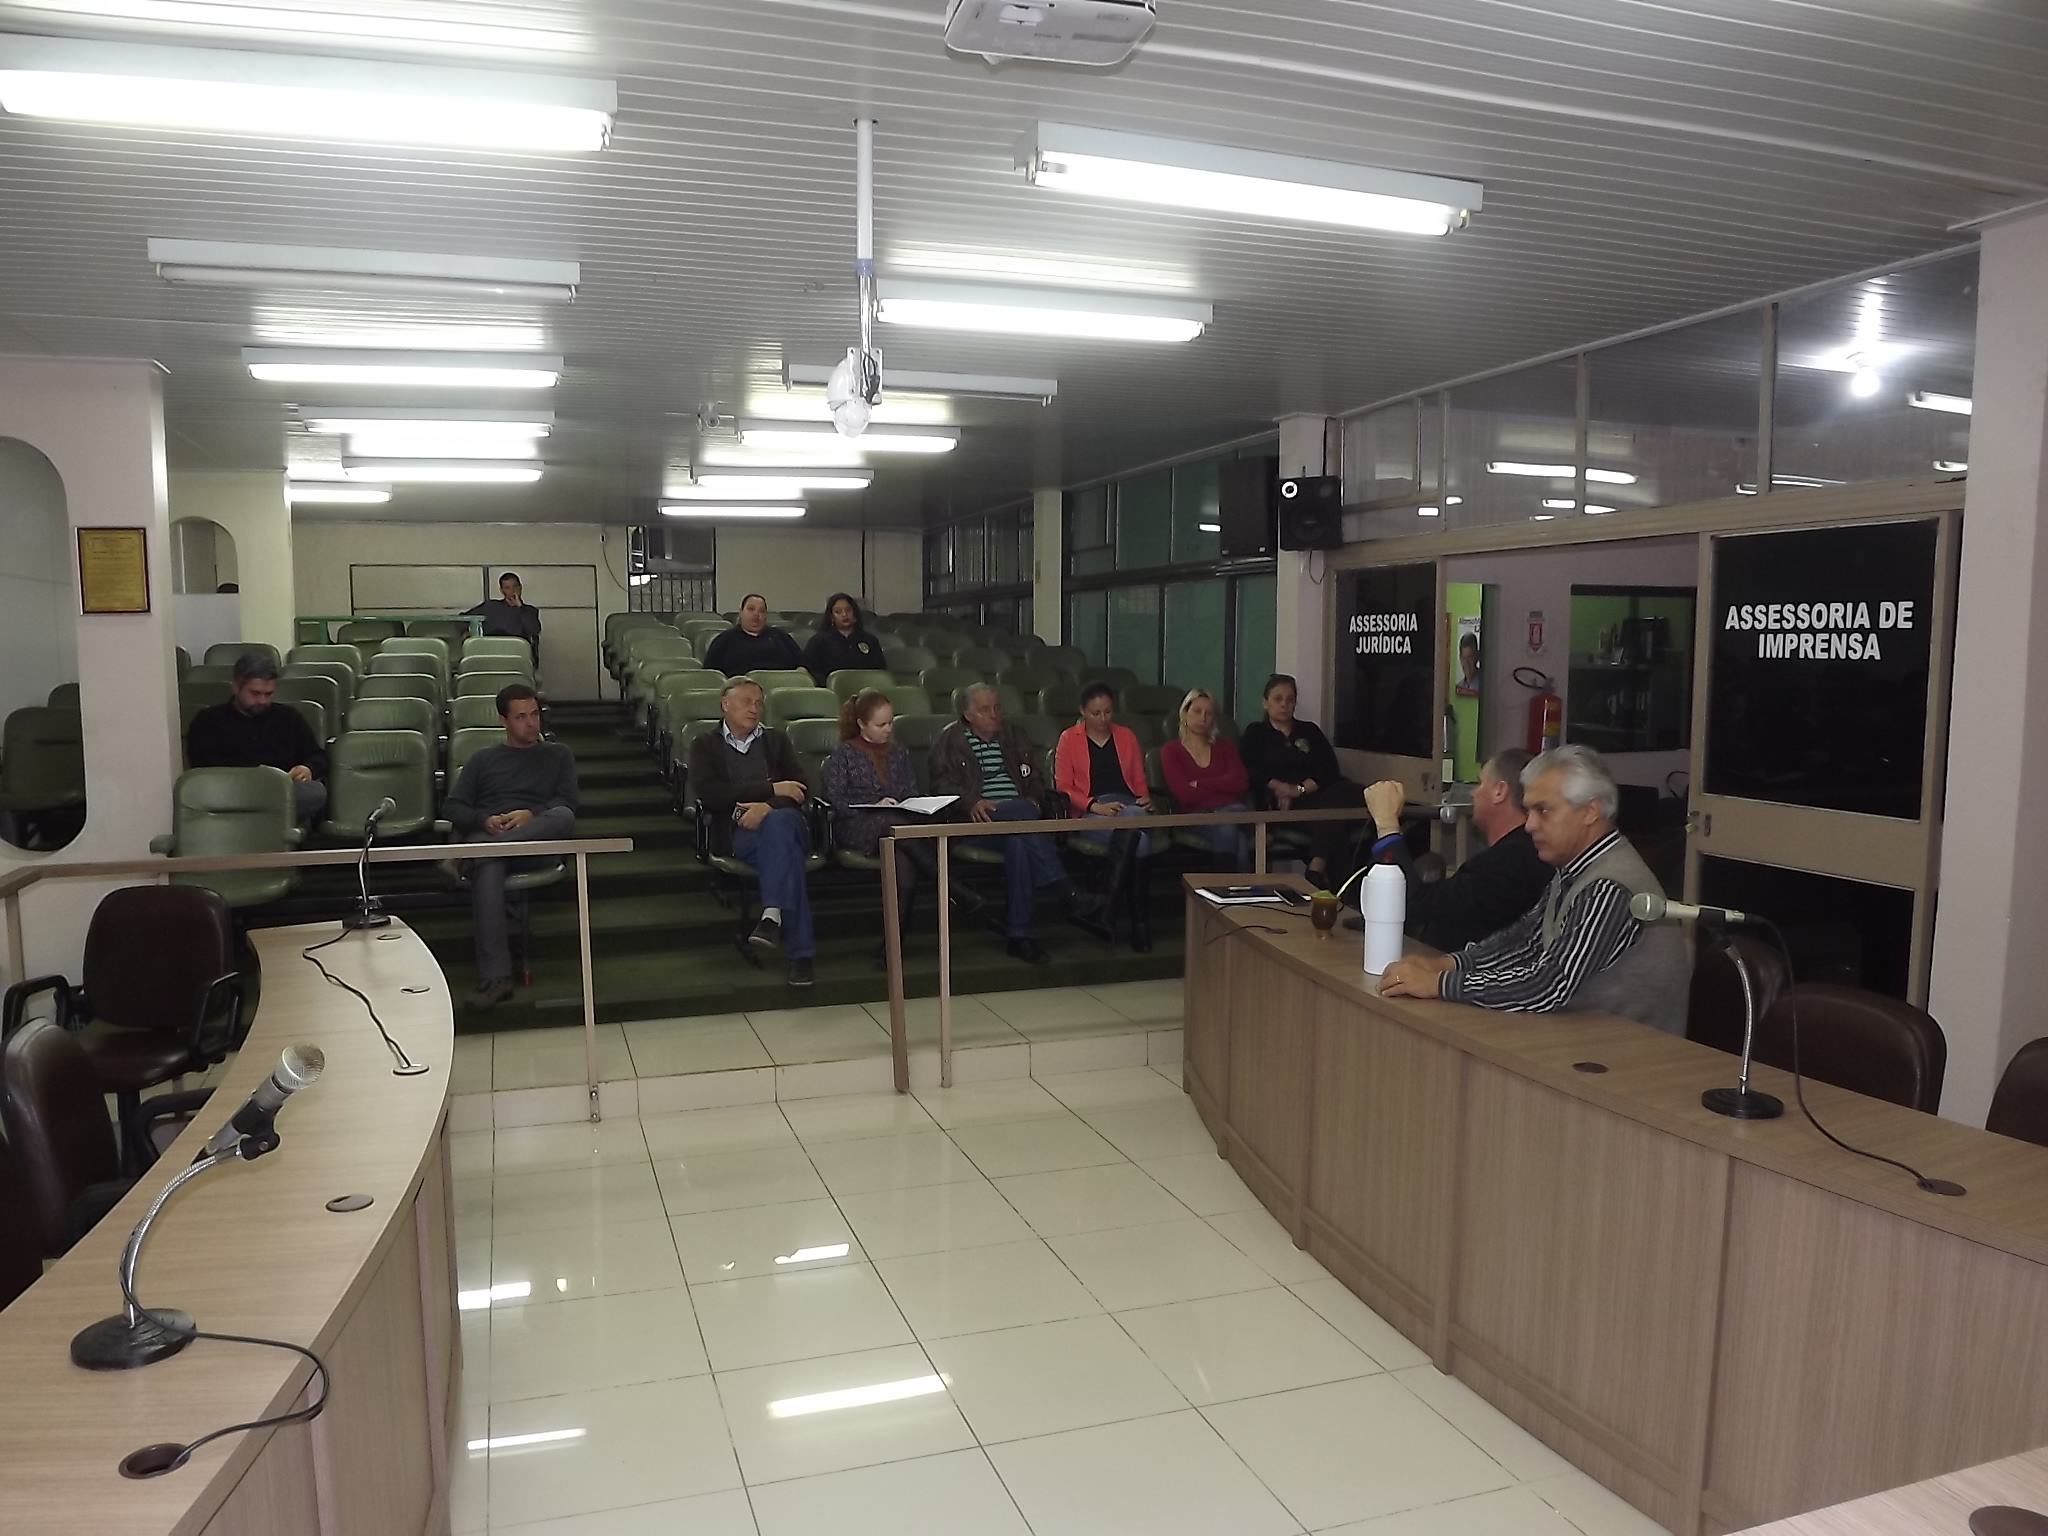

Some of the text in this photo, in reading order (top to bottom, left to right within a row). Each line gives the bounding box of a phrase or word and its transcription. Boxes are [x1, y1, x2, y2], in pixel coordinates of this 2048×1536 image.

[1349, 612, 1418, 633] ASSESSORIA
[1724, 600, 1914, 630] ASSESSORIA DE
[1355, 632, 1412, 654] JURÍDICA
[1757, 632, 1881, 660] IMPRENSA
